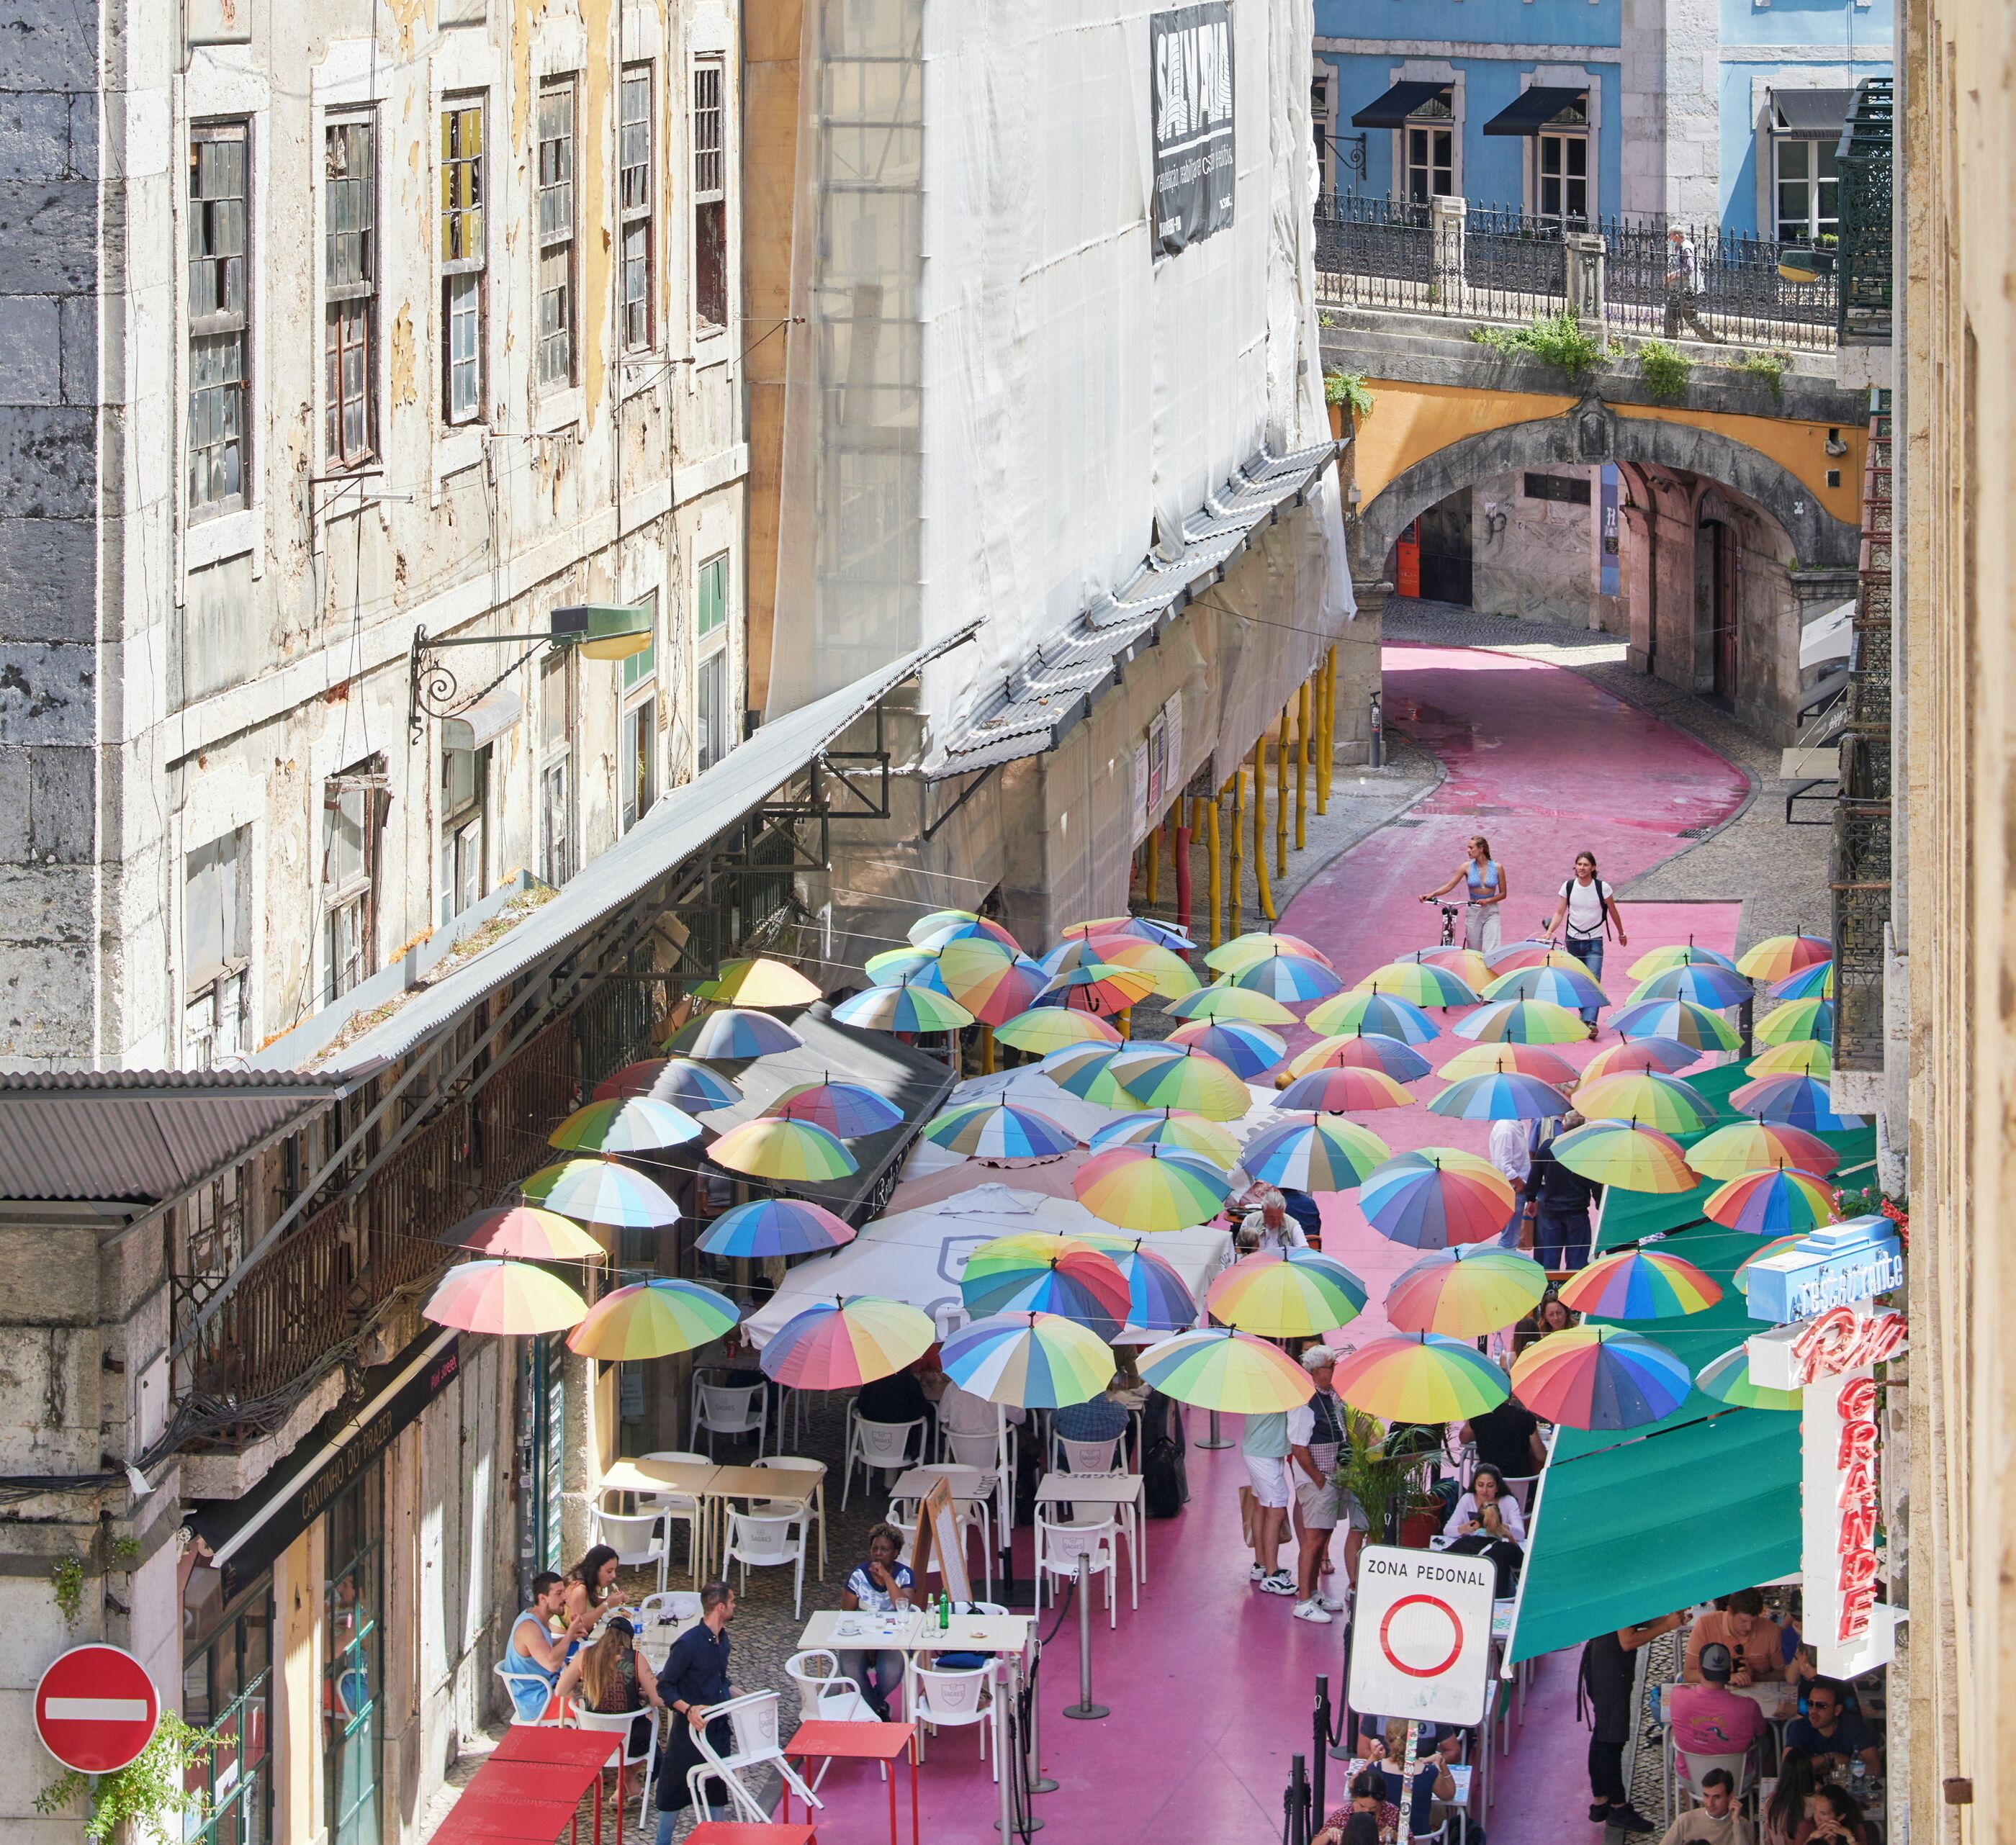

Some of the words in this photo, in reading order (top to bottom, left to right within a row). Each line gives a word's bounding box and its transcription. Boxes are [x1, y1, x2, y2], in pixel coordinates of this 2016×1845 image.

[1798, 1250, 1903, 1317] restaurante
[302, 1457, 344, 1520] CANTINHO
[347, 1442, 360, 1475] DO
[364, 1410, 392, 1459] PRAZER
[750, 1534, 772, 1543] SAGRES
[1837, 1376, 1878, 1641] GRANDE
[1368, 1559, 1408, 1577] ZONA
[1417, 1565, 1485, 1587] PEDONAL
